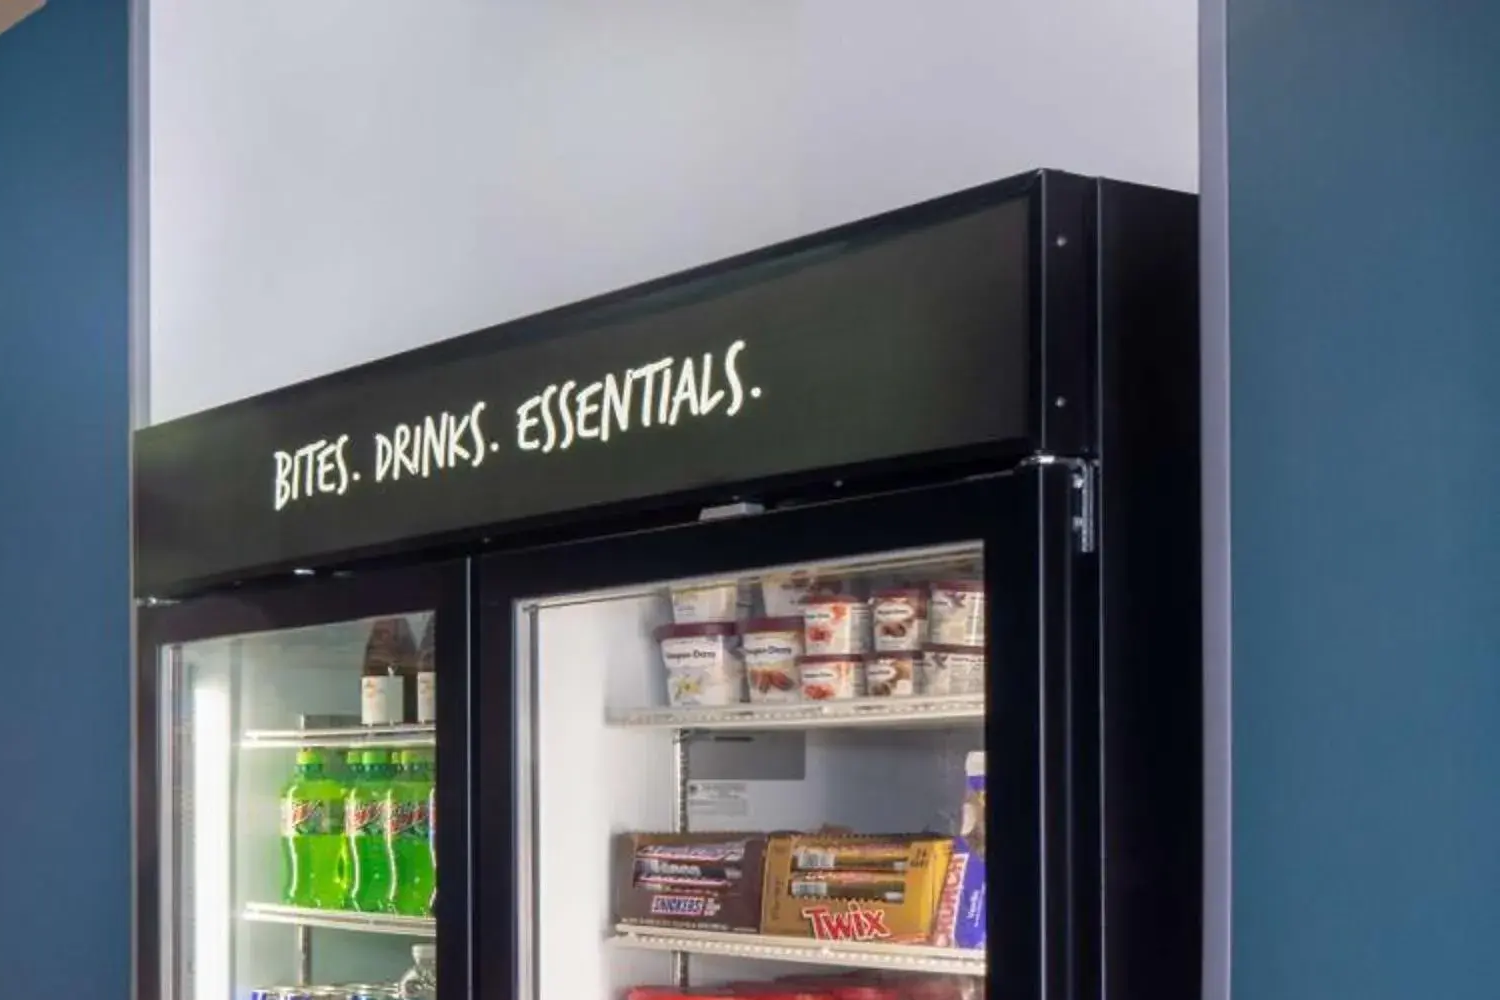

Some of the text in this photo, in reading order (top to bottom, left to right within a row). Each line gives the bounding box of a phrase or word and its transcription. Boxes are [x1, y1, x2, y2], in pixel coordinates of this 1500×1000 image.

[274, 340, 761, 511] BITES. DRINKS. ESSENTIALS.
